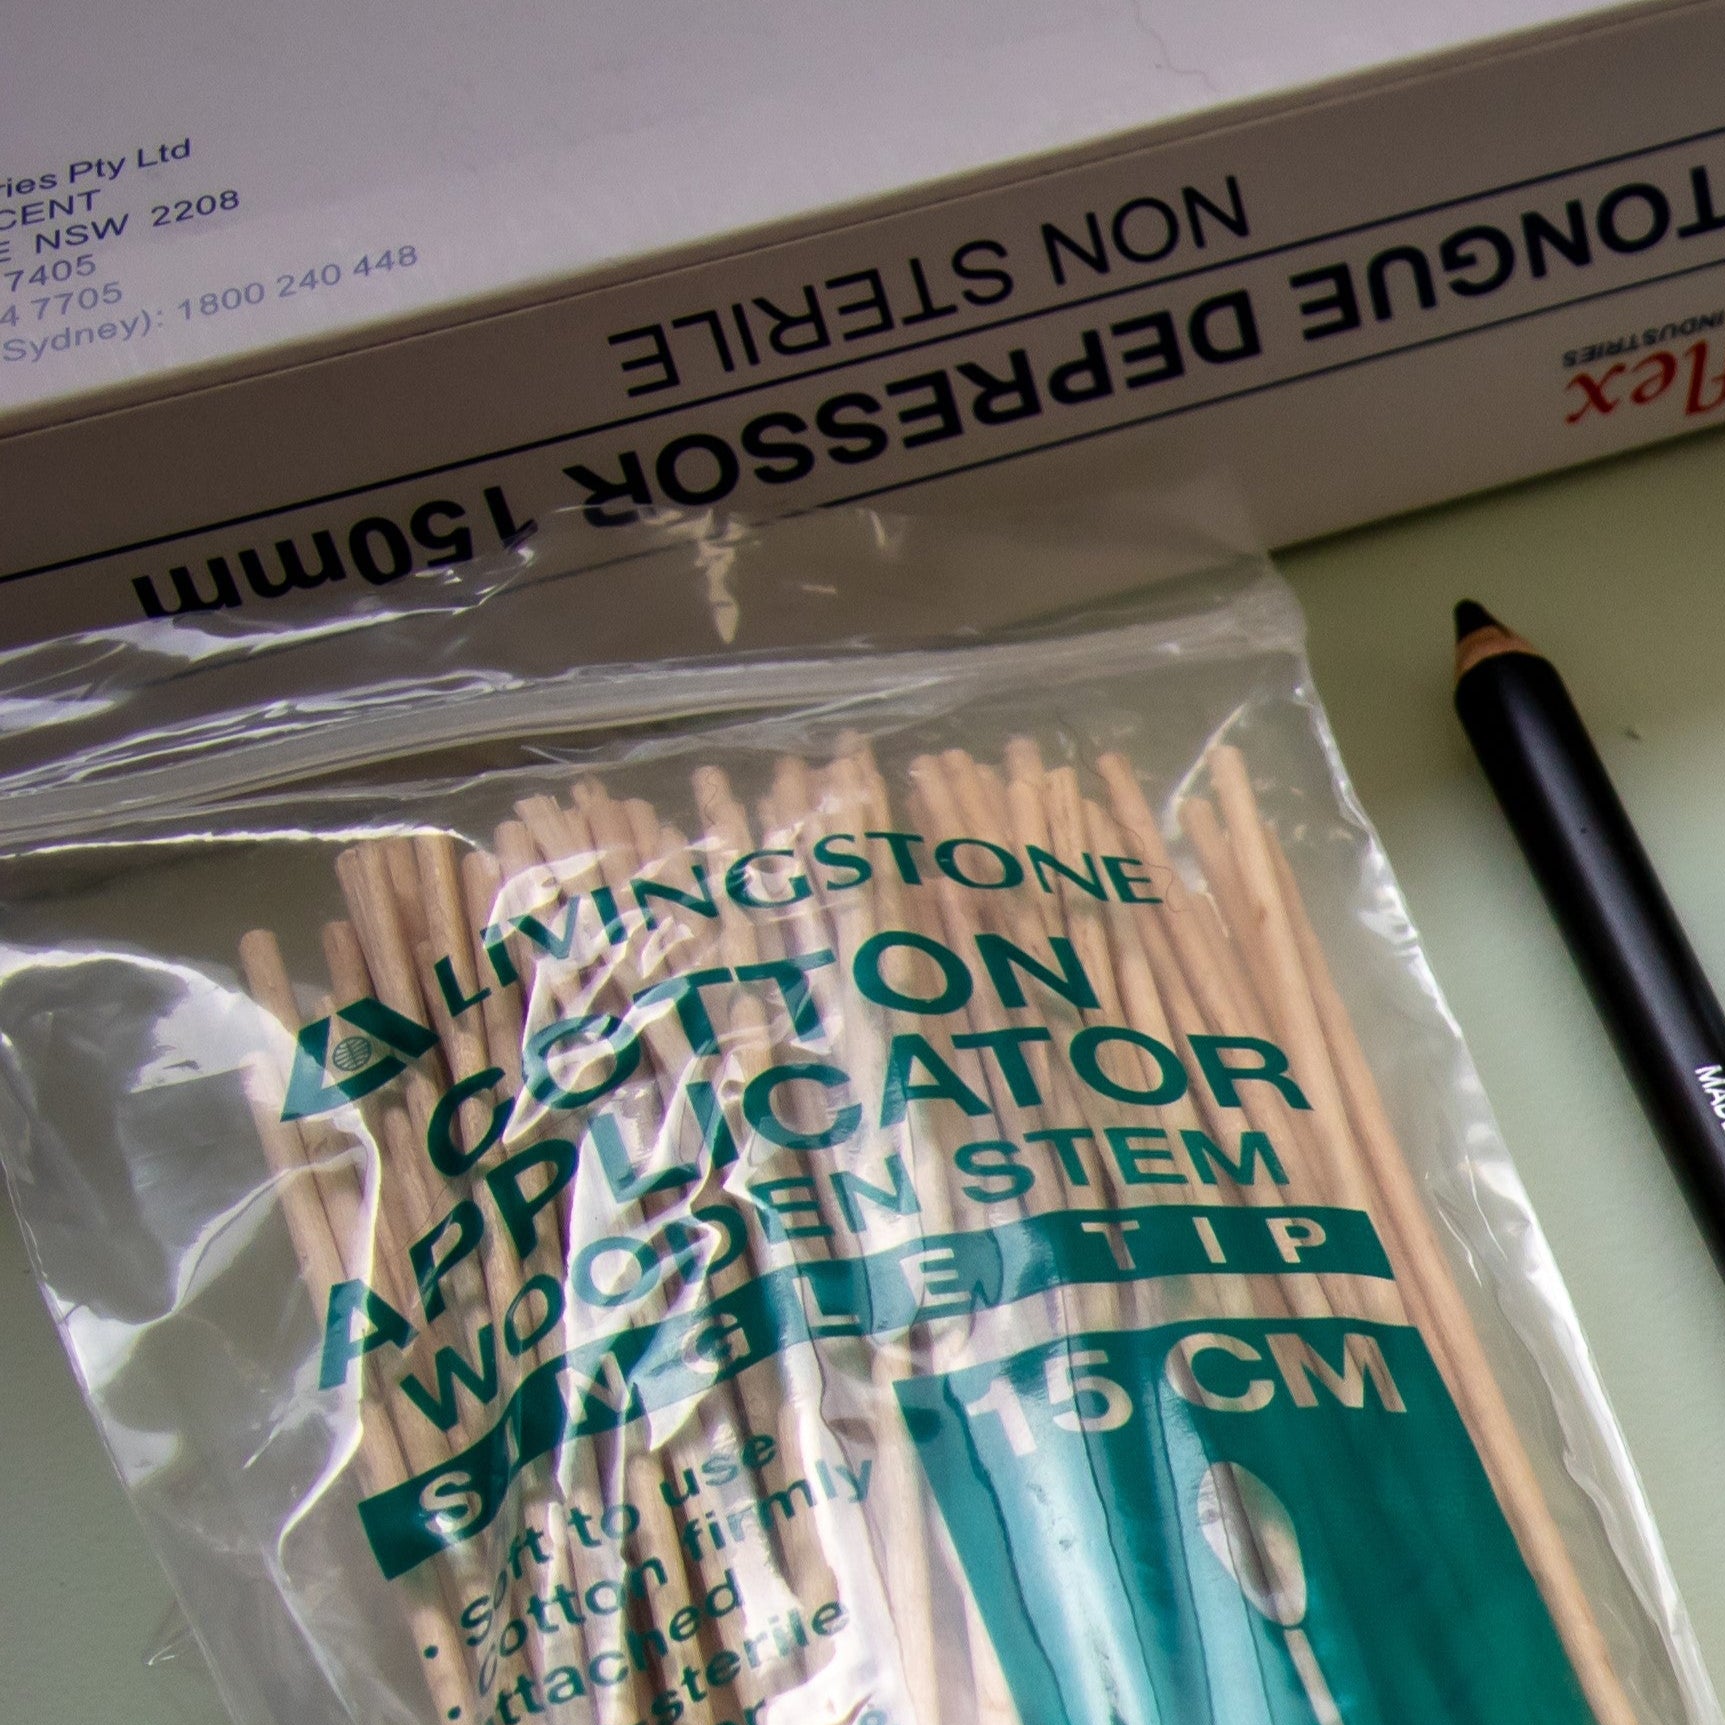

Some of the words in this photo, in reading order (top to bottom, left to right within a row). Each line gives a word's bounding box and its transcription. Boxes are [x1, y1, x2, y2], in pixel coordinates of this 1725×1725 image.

[35, 212, 129, 254] NSW
[151, 189, 240, 228] 2208
[69, 156, 126, 184] Pty
[137, 137, 191, 168] Ltd
[4, 253, 97, 293] 7405
[1041, 175, 1250, 286] NON
[2, 308, 164, 363] Sydney):
[178, 281, 266, 323] 1800
[276, 262, 343, 299] 240
[352, 243, 419, 278] 448
[30, 281, 123, 321] 7705
[607, 239, 1015, 397] STERILE
[1562, 308, 1725, 368] INDUSTRIES
[561, 288, 1263, 530] DEPRESSOR
[131, 485, 540, 619] 150mm
[434, 831, 1163, 1018] LIVINGSTONE
[427, 930, 1100, 1177] COTTON
[318, 1025, 1313, 1391] APPLICATOR
[400, 1154, 920, 1434] WOODEN
[952, 1125, 1291, 1204] STEM
[419, 1247, 988, 1535] SINGLE
[1083, 1215, 1327, 1270] TIP
[968, 1349, 1133, 1456] 15
[1165, 1331, 1408, 1413] CM
[460, 1526, 552, 1647] Soft
[568, 1504, 640, 1548] to
[658, 1433, 777, 1508] use
[682, 1459, 872, 1562] firmly
